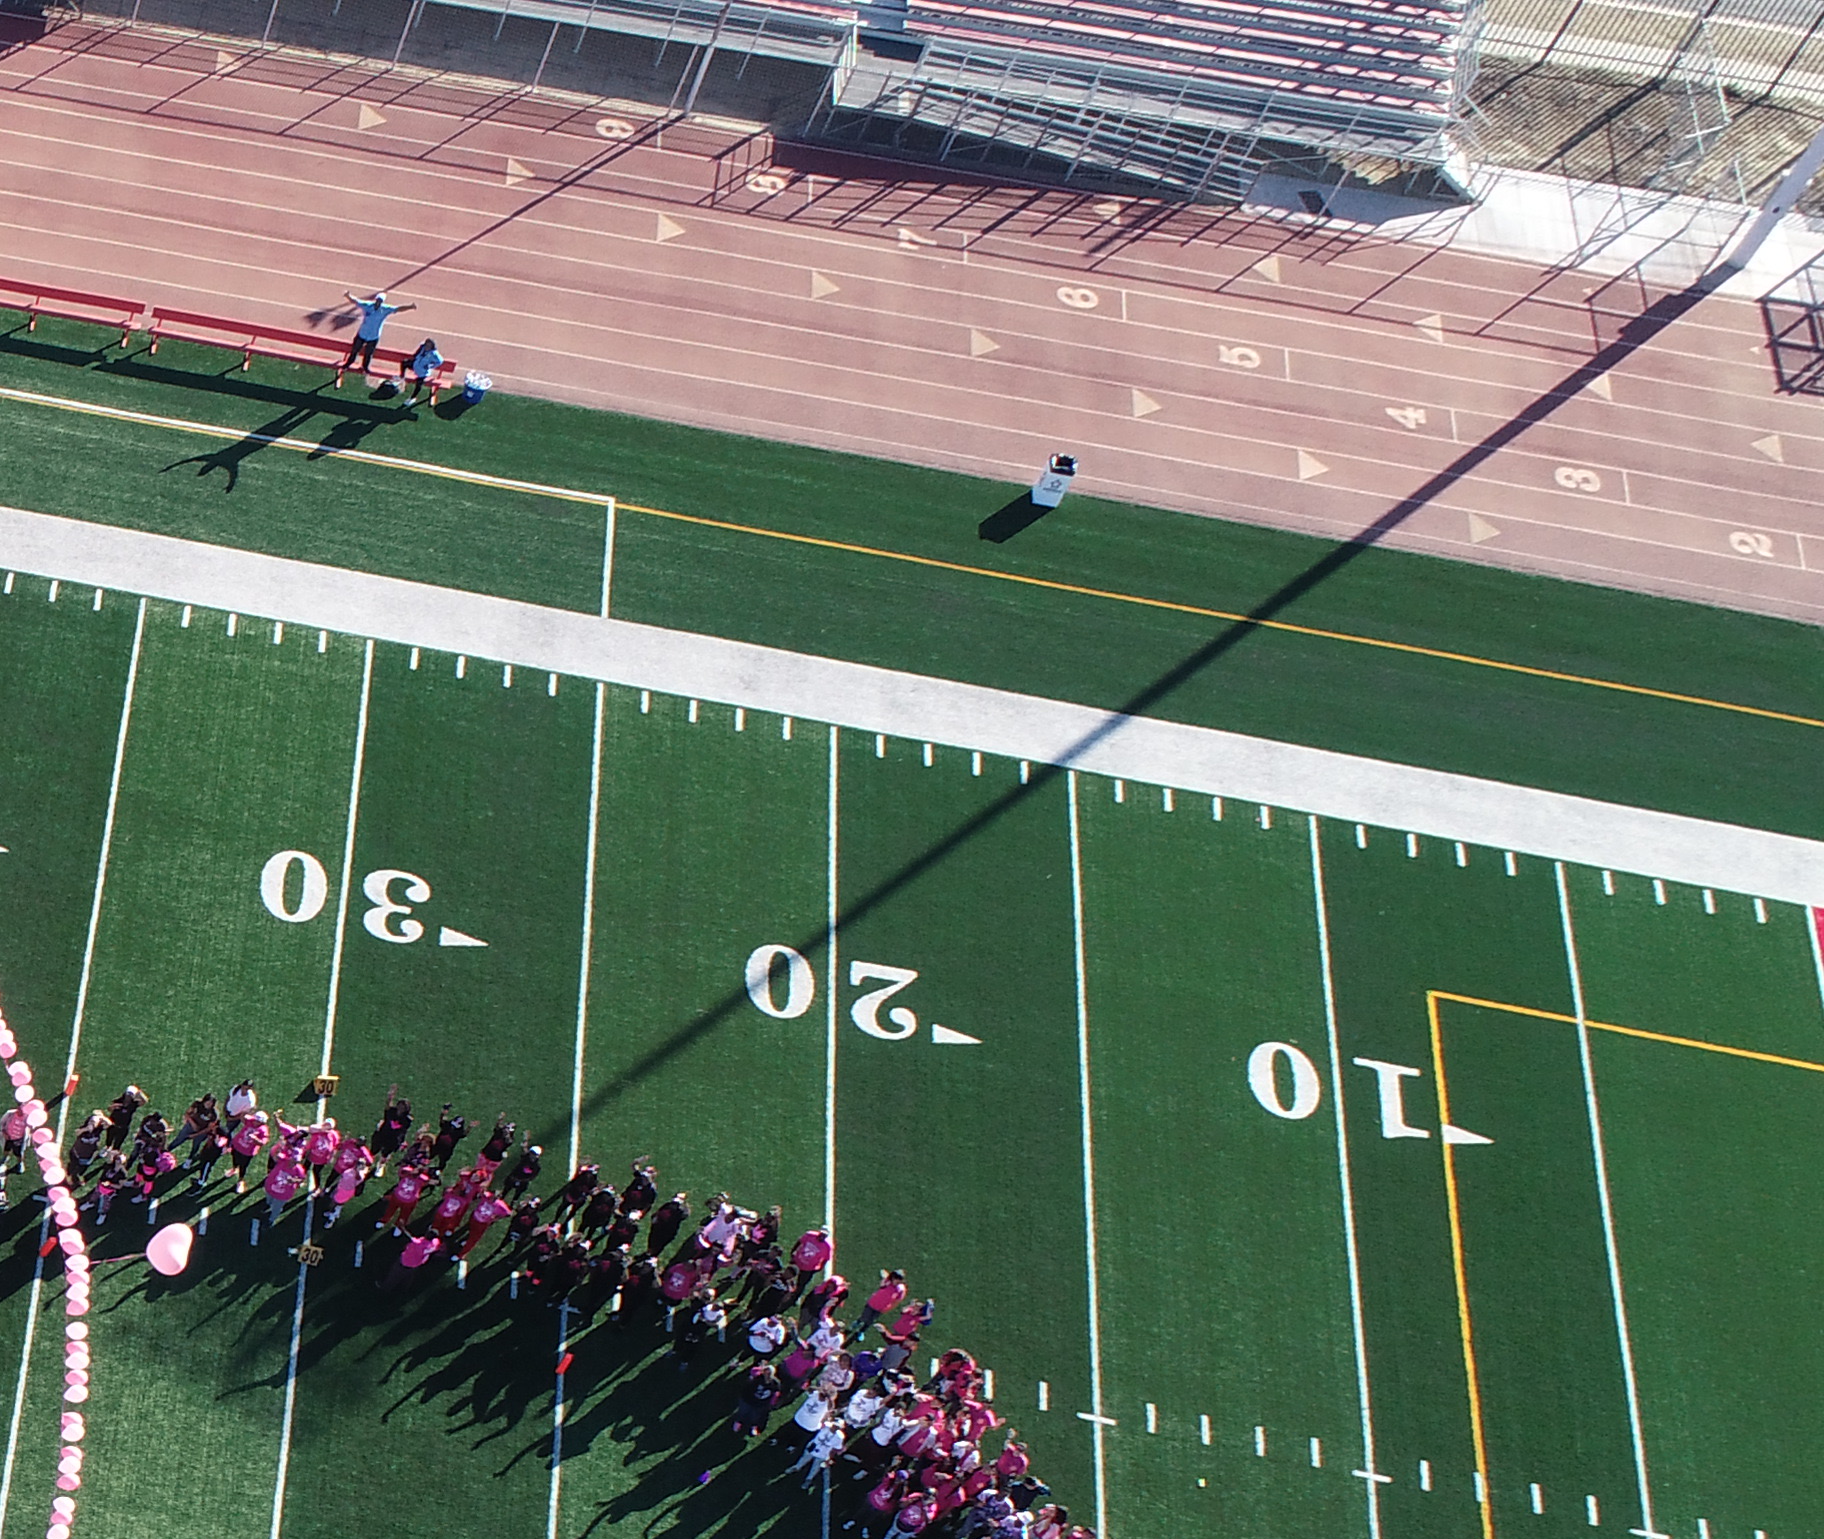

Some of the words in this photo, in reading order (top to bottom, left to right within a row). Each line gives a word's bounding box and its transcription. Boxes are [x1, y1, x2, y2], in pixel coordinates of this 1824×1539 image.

[1056, 287, 1099, 309] 6
[1219, 345, 1261, 369] 5
[1385, 407, 1427, 429] 4
[1554, 466, 1602, 493] 3
[1729, 531, 1774, 558] 2
[260, 851, 430, 943] 30
[746, 945, 917, 1039] 20
[1249, 1042, 1429, 1138] 10
